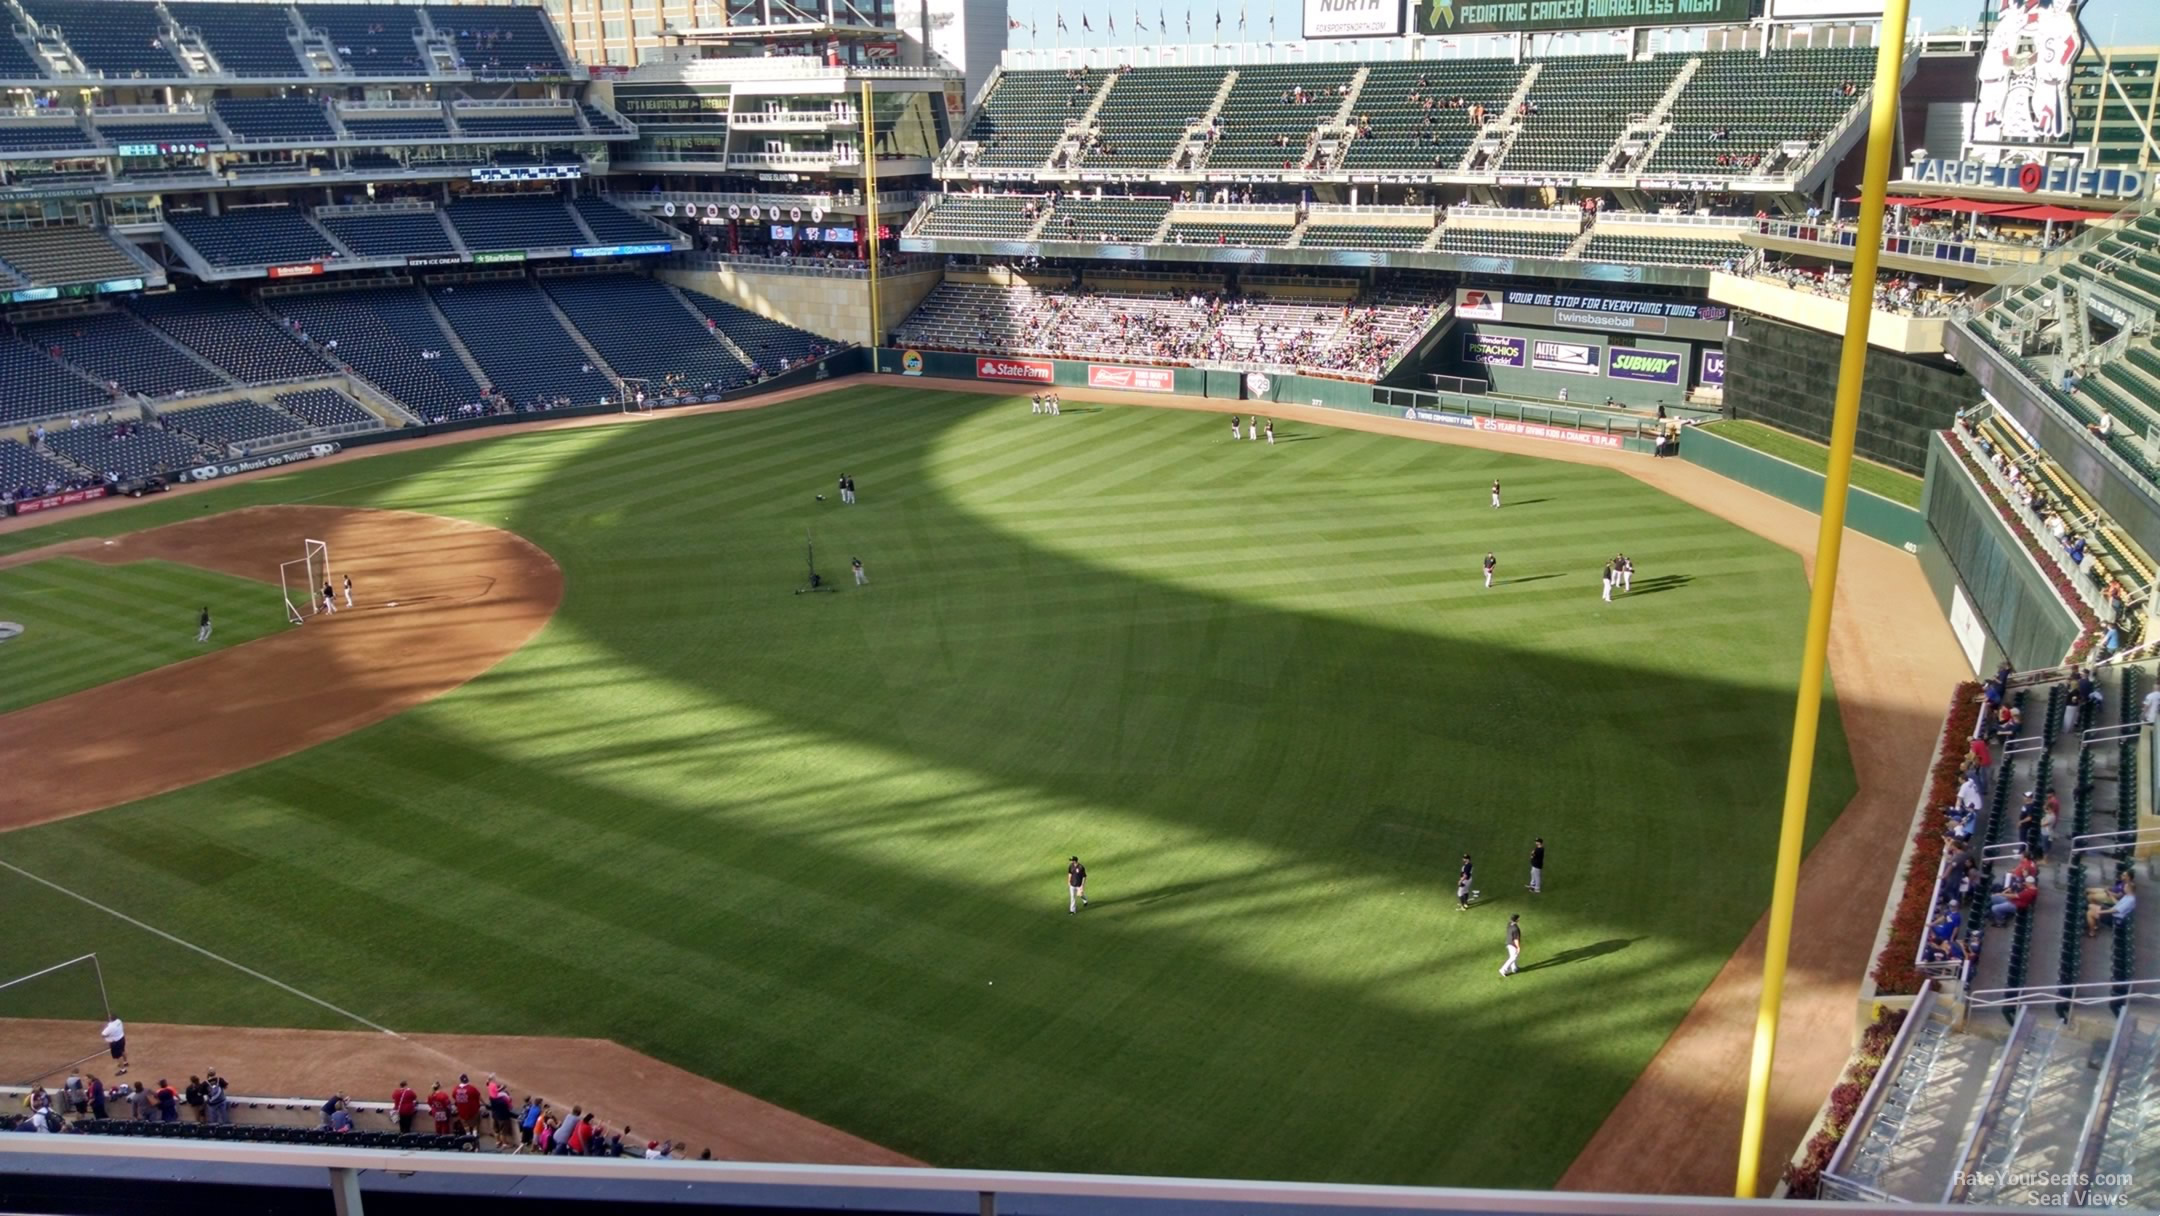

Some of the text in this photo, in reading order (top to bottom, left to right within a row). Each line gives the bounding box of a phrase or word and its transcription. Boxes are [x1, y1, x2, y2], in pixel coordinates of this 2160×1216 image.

[1460, 3, 1527, 24] PEDIATRIC
[1530, 0, 1584, 20] CANCER
[1586, 0, 1674, 18] AWARENESS
[1315, 22, 1387, 32] FOXSPORTSNORTH.COM
[1909, 158, 2144, 199] TARGET FIELD
[1508, 292, 1697, 317] YOUR ONE STOP FOR EVERYTHING TWINS
[1697, 306, 1726, 321] Twins
[1469, 343, 1520, 357] PISTACHIOS
[1535, 342, 1560, 356] ALTEC
[1612, 354, 1678, 374] SUBWAY
[1257, 380, 1269, 390] 29
[1484, 419, 1497, 430] 25
[1497, 422, 1516, 433] YEARS
[1516, 425, 1525, 433] OF
[1525, 426, 1545, 437] GIVING
[1545, 428, 1560, 439] KIDS
[1566, 431, 1591, 443] CHANCE
[1591, 435, 1601, 445] TO
[222, 465, 238, 475] Go
[239, 460, 267, 472] Music
[268, 457, 283, 466] Go
[283, 451, 310, 463] Twins
[1903, 541, 1917, 554] 403
